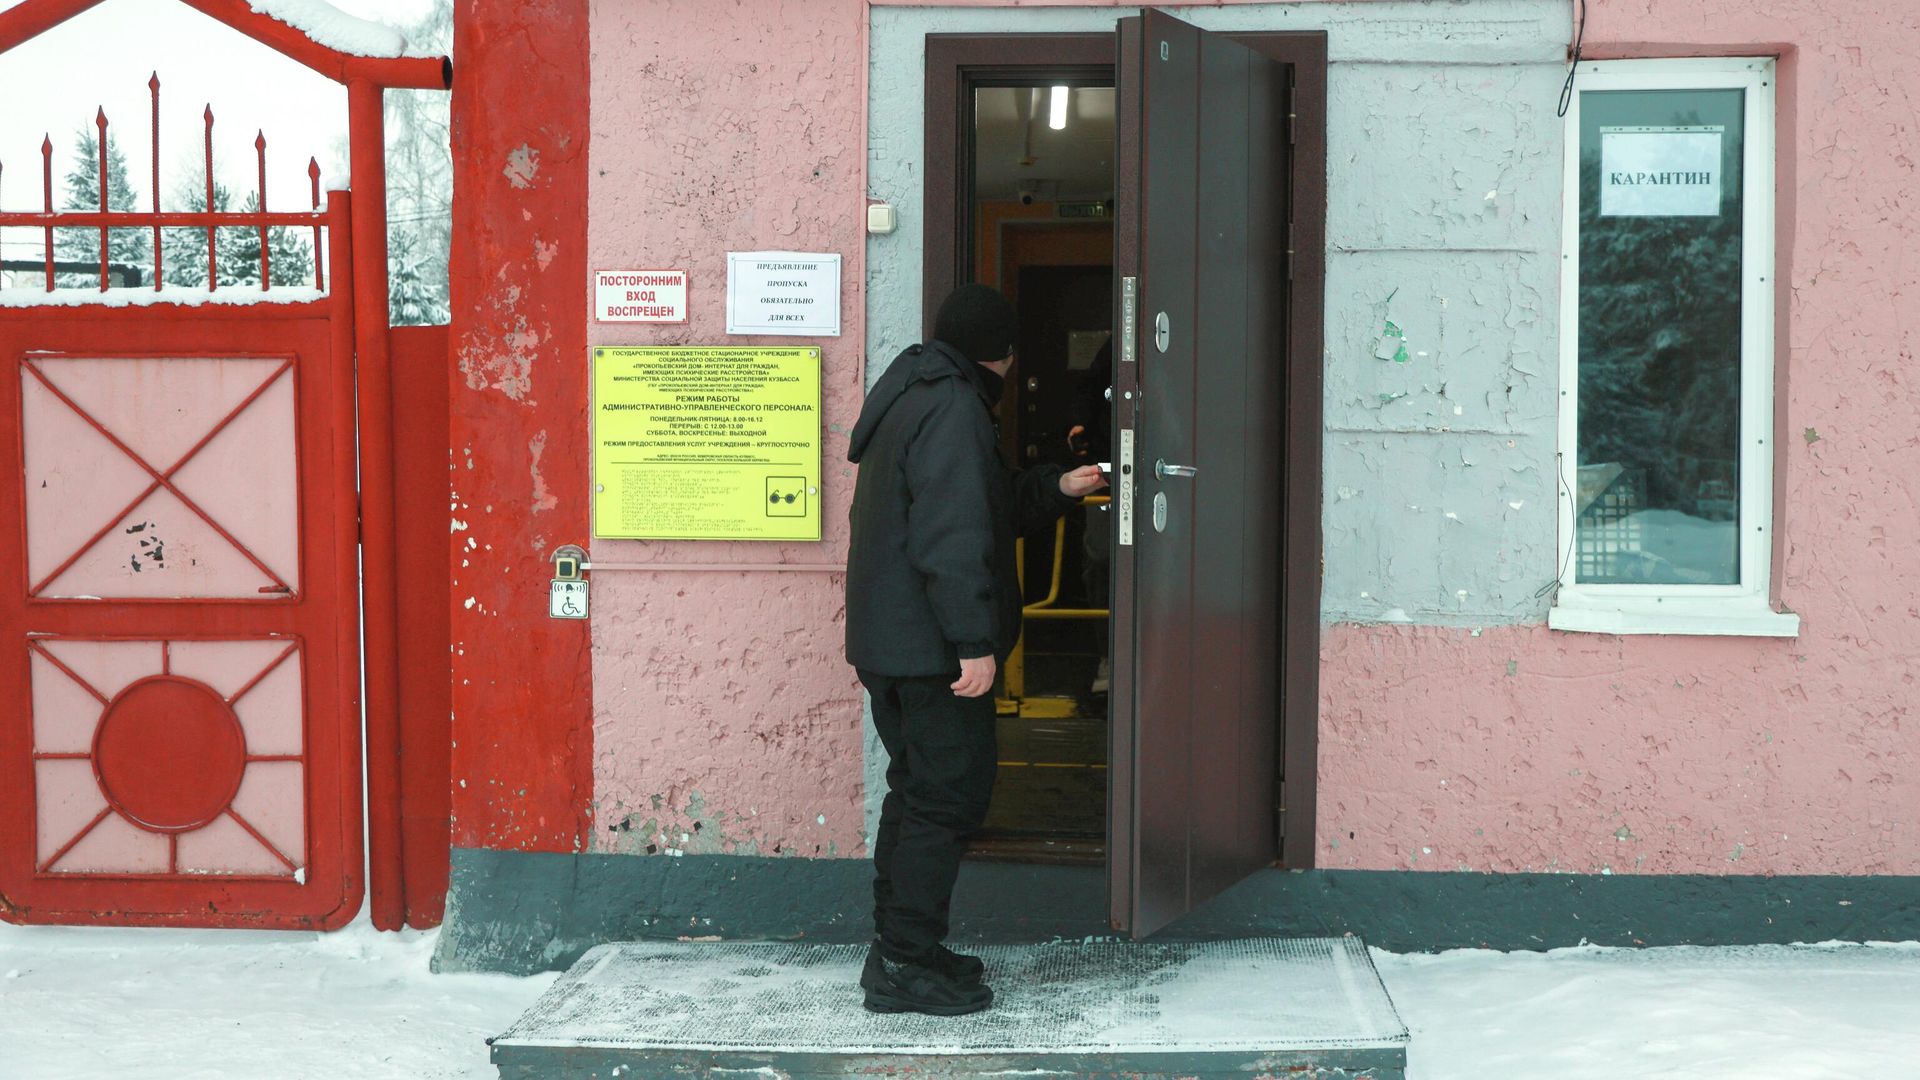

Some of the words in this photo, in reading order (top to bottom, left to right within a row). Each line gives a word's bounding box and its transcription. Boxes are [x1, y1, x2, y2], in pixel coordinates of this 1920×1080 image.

[1611, 172, 1710, 185] КАРАНТИН
[600, 276, 682, 286] ПОСТОРОННИМ
[626, 291, 655, 302] ВХОД
[607, 306, 674, 318] ВОСПРЕЩЕН
